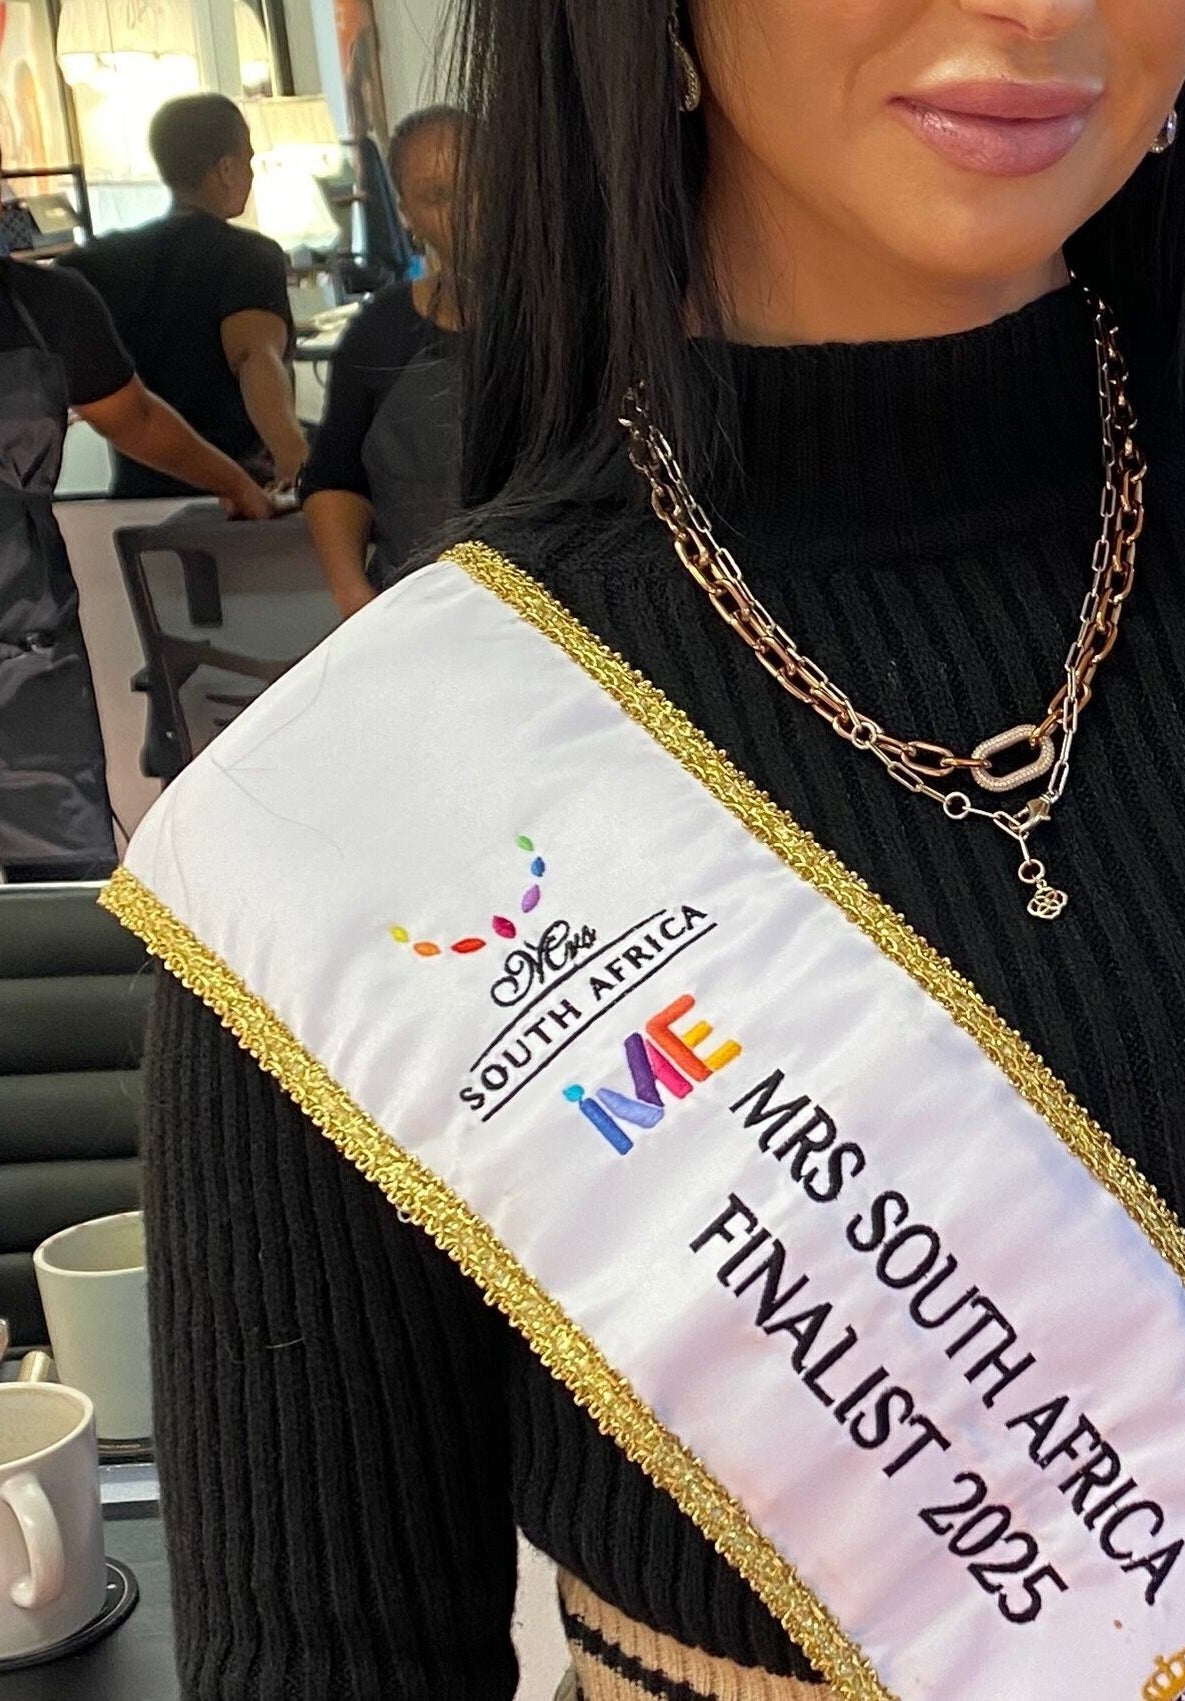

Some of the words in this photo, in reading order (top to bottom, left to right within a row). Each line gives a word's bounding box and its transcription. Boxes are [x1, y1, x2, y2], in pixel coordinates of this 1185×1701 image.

[459, 998, 582, 1112] SOUTH
[588, 904, 708, 1000] AFRICA
[491, 920, 597, 1007] Mrs
[689, 1193, 952, 1478] FINALIST
[918, 1470, 1070, 1625] 2025
[728, 1068, 867, 1204] MRS
[846, 1190, 1038, 1408] SOUTH
[1006, 1394, 1185, 1606] AFRICA
